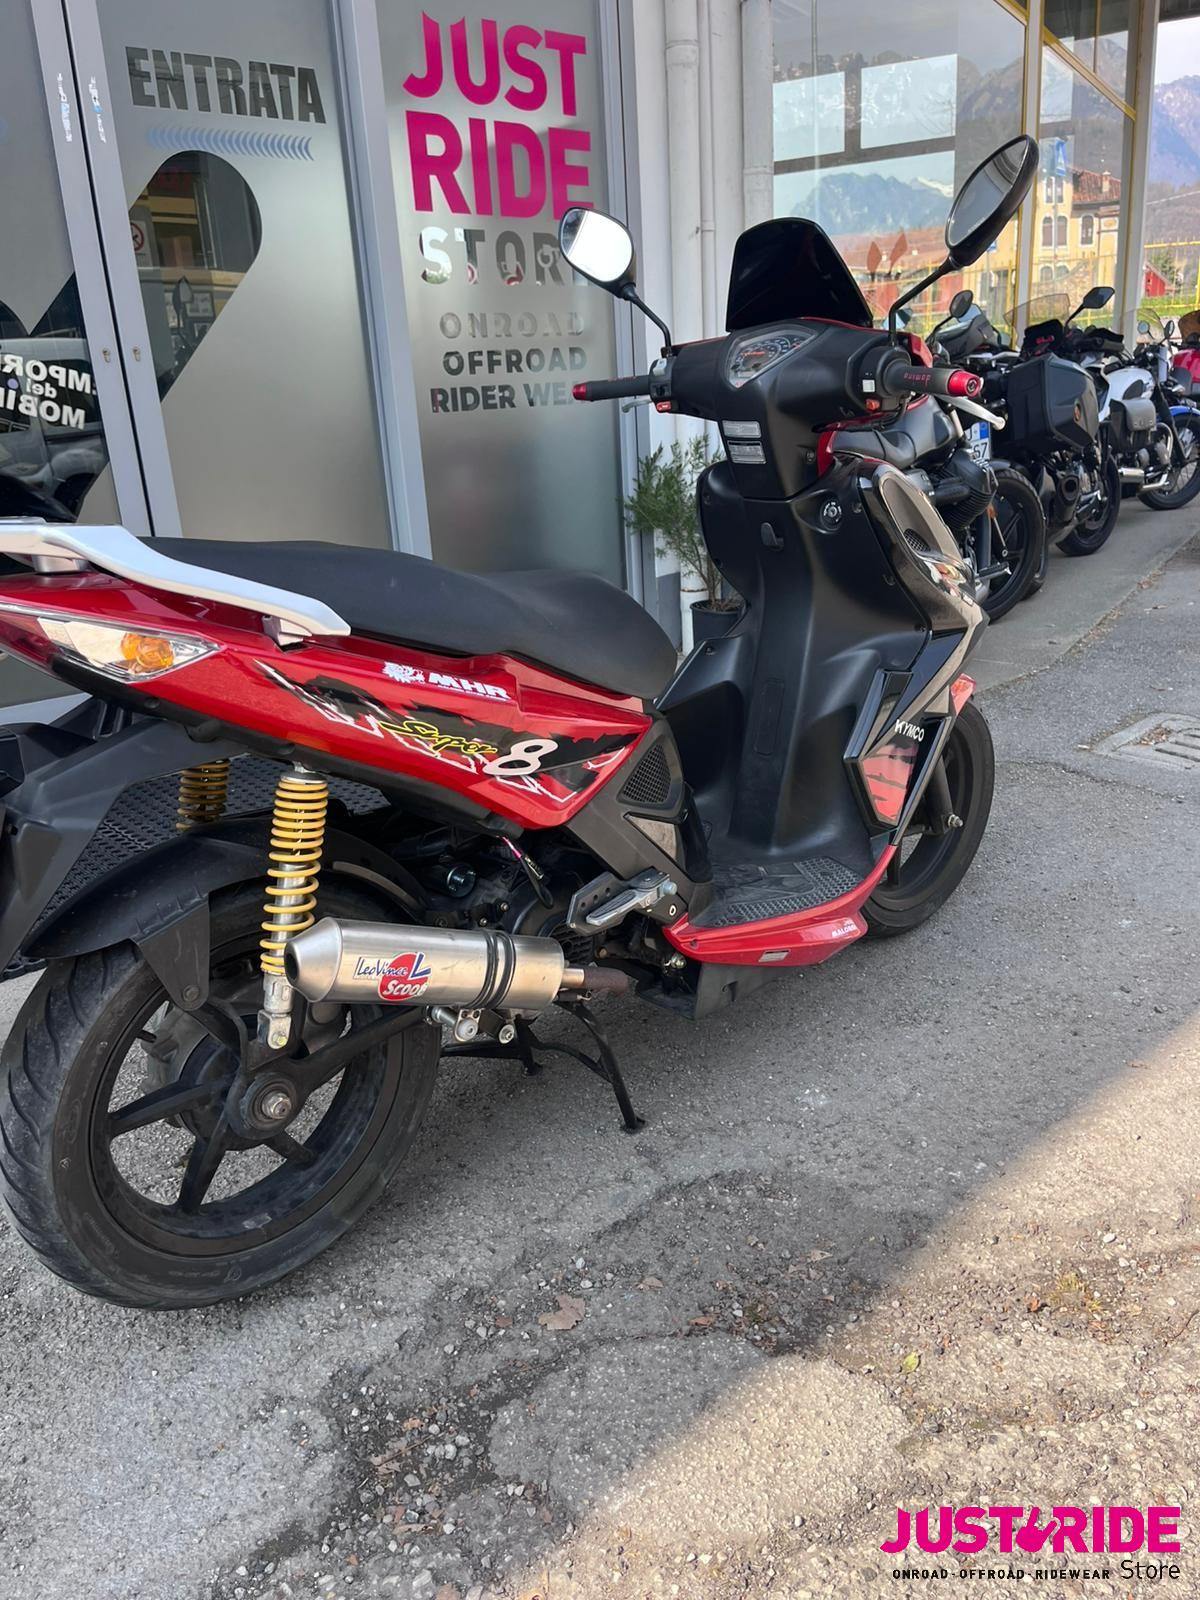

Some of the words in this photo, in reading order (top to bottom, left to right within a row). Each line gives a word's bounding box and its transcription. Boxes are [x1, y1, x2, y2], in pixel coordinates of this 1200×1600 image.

[403, 10, 587, 117] JUST
[125, 46, 326, 124] ENTRATA
[405, 110, 594, 220] RIDE
[440, 311, 586, 339] ONROAD
[442, 346, 588, 376] OFFROAD
[430, 384, 517, 413] RIDER
[428, 672, 511, 701] MHR
[895, 719, 925, 742] KYMCO
[378, 720, 498, 755] Super
[482, 738, 558, 776] 8
